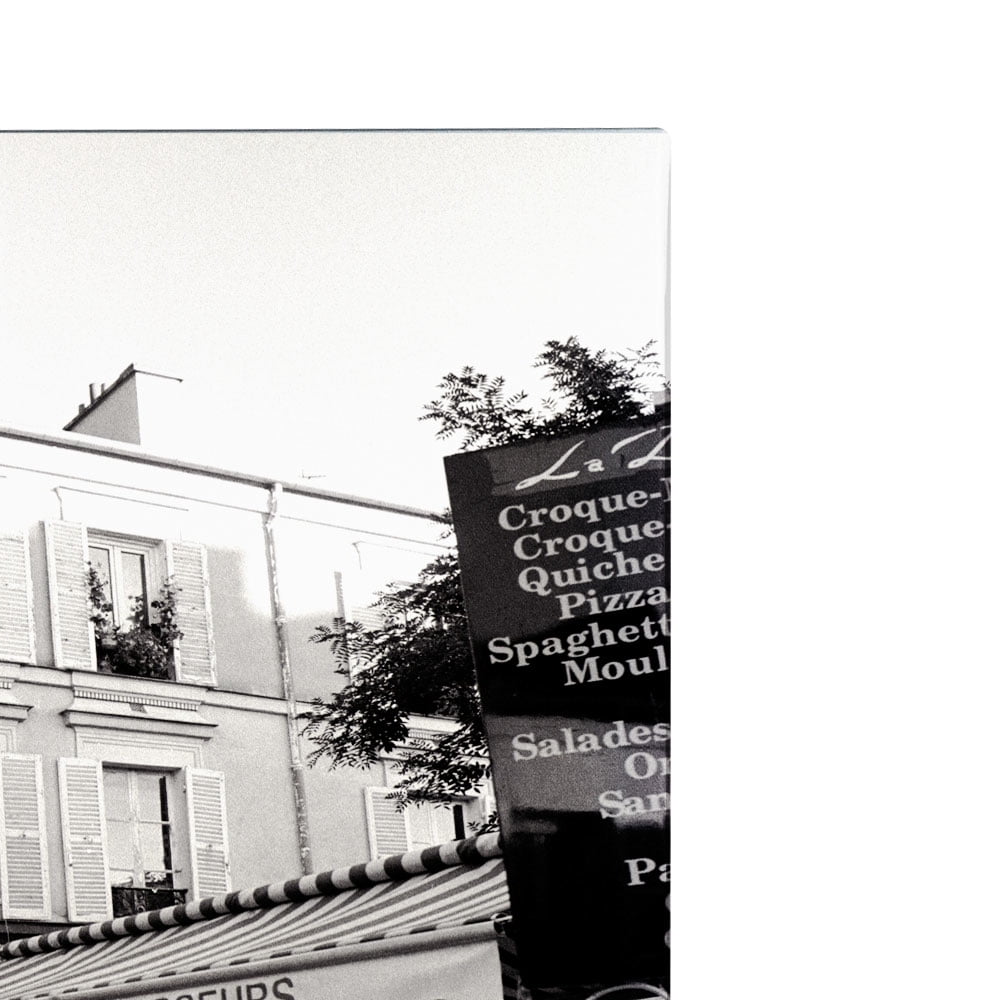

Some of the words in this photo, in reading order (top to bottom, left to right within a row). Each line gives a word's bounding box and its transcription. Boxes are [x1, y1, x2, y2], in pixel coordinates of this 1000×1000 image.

[518, 552, 665, 596] Quiche
[555, 585, 670, 620] Pizza
[487, 613, 670, 667] Spaghett
[561, 645, 669, 686] Moul
[511, 720, 670, 762] Salades
